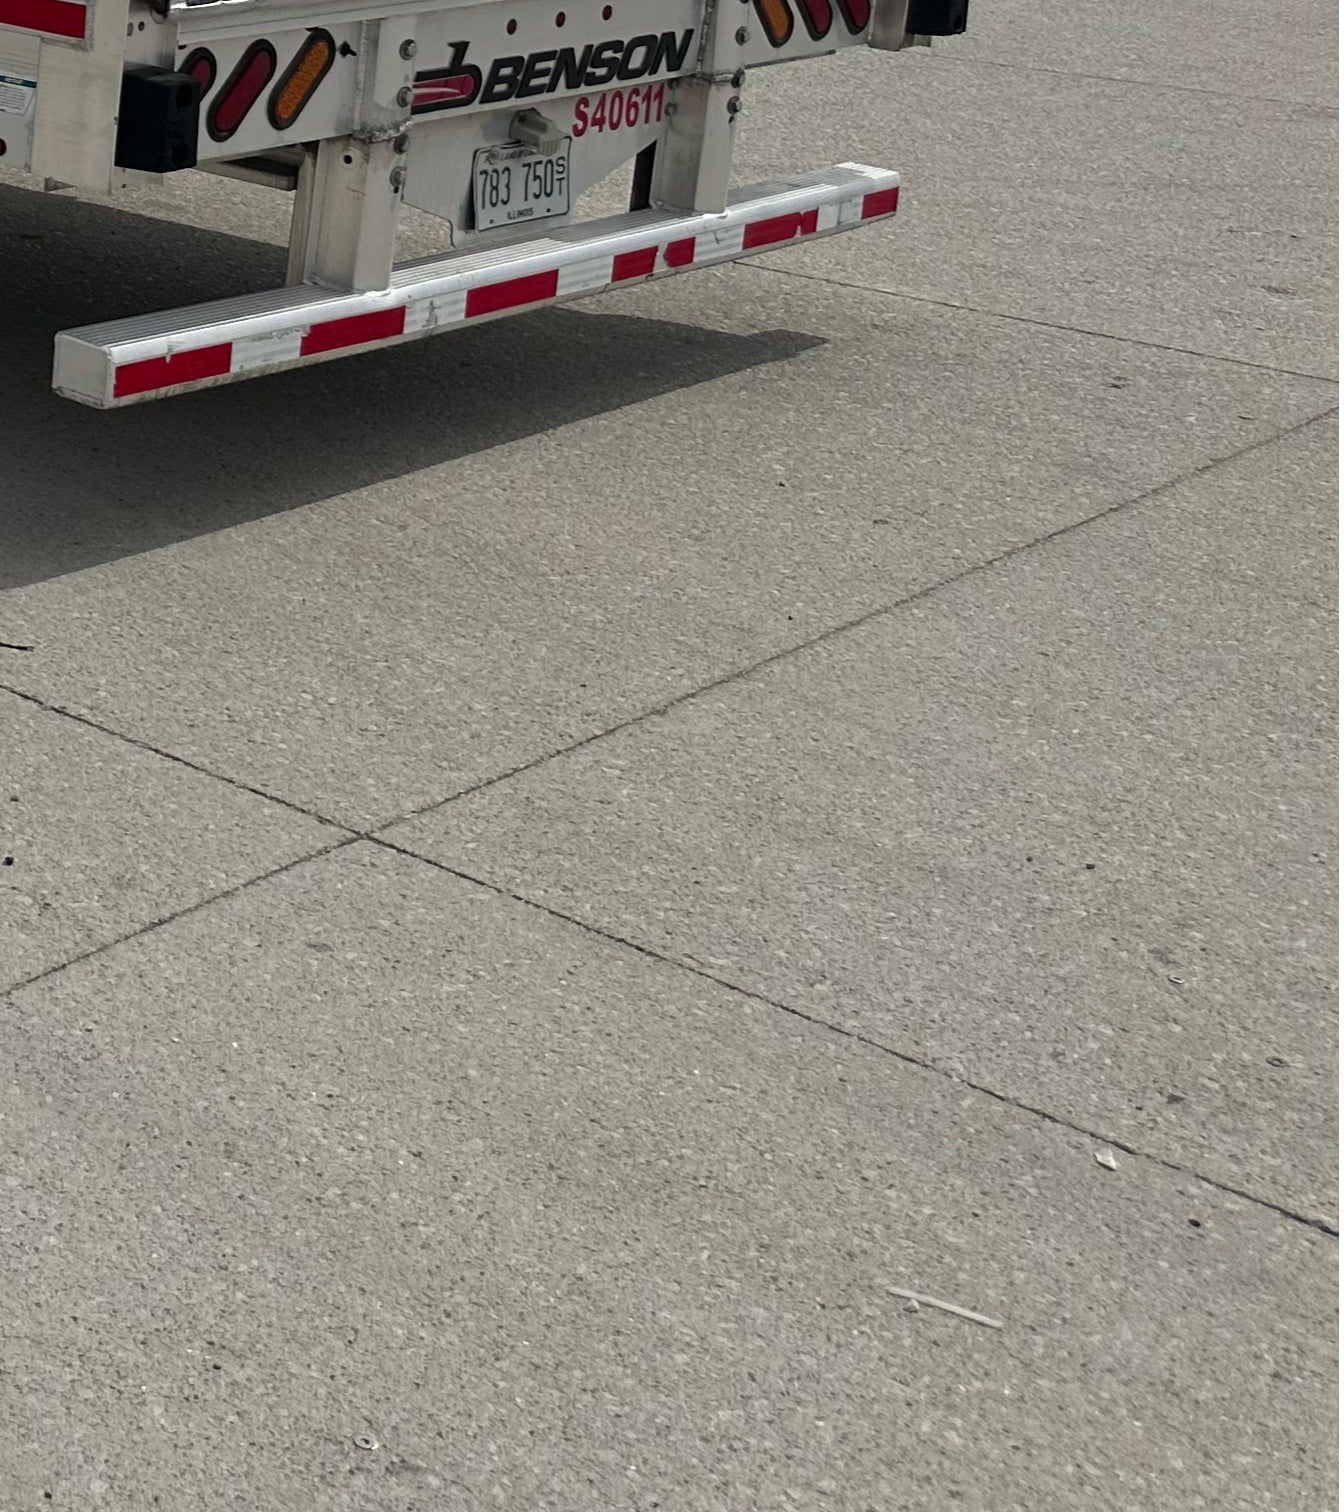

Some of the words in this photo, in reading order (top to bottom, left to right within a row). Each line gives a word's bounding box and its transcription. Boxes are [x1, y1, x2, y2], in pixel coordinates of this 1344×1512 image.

[478, 29, 694, 105] BENSON
[572, 81, 665, 138] S40611
[479, 166, 511, 210] 783
[522, 159, 554, 202] 750
